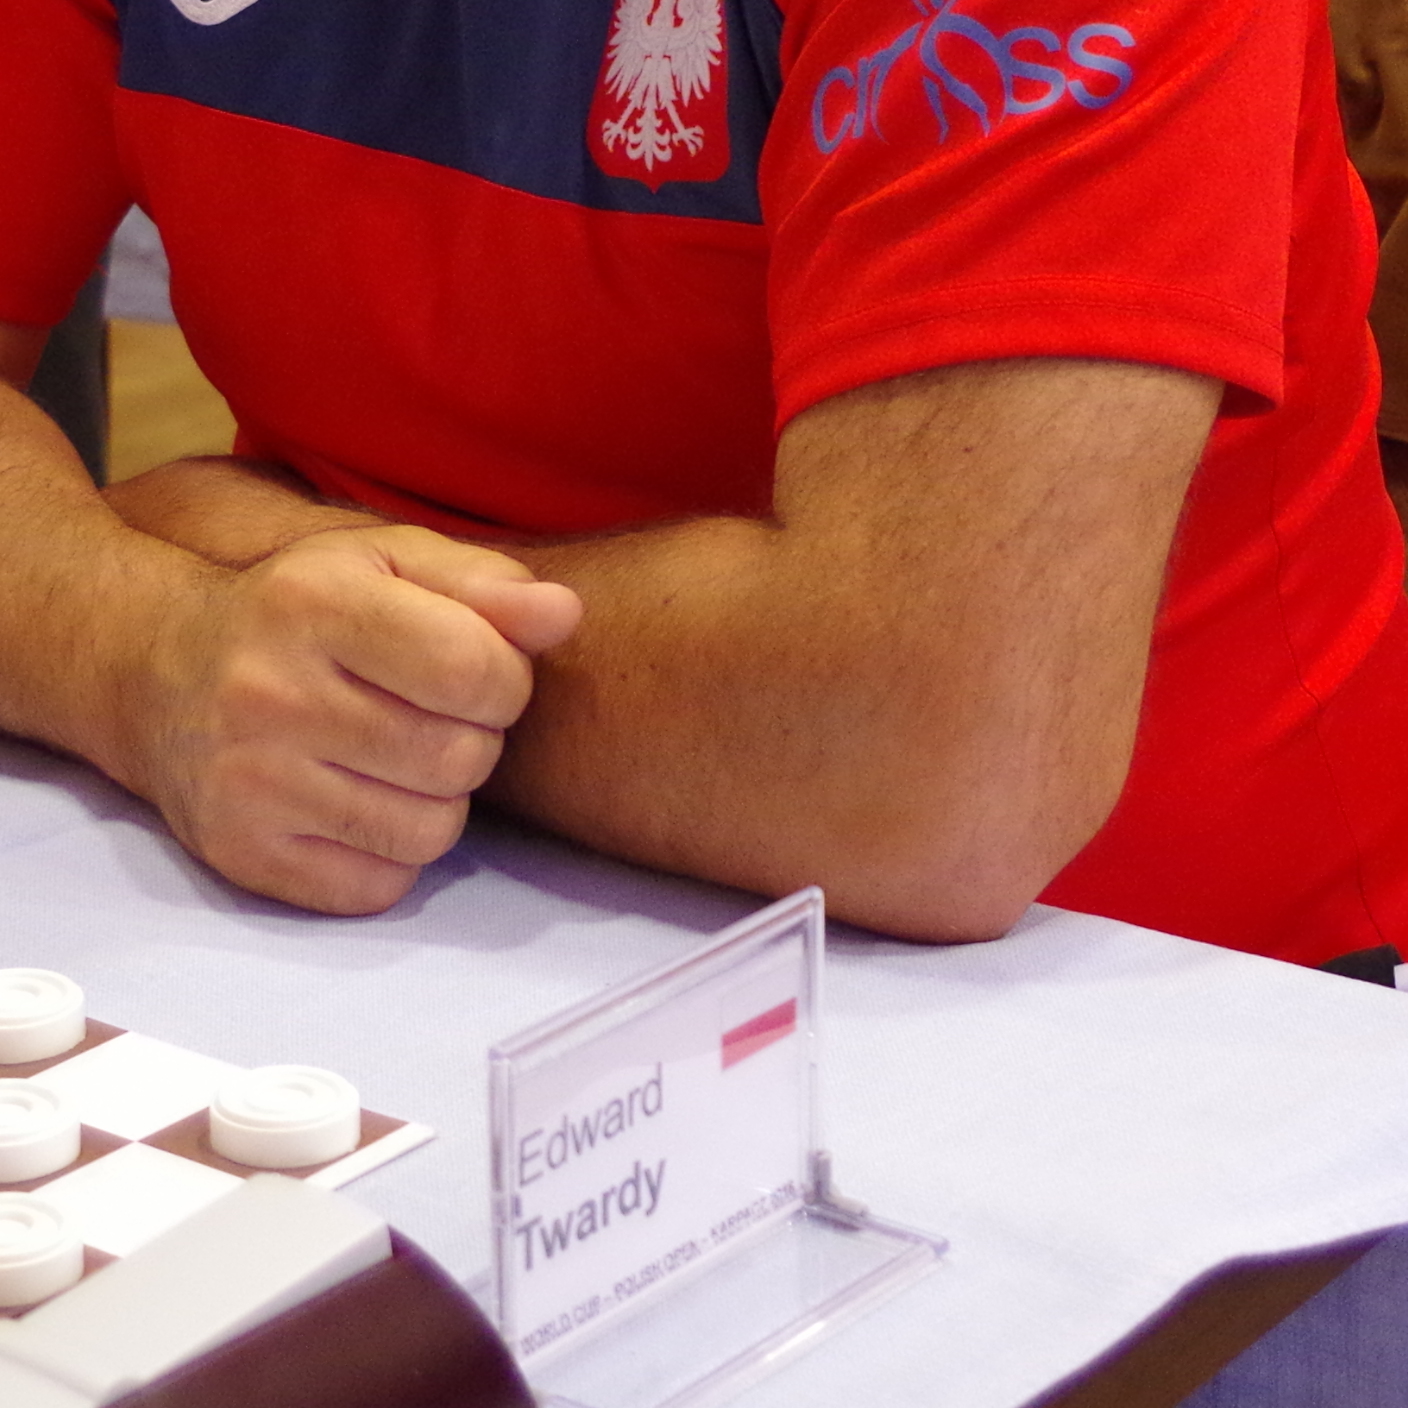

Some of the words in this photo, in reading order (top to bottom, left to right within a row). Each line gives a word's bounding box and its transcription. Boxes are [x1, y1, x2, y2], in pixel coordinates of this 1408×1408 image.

[518, 1061, 662, 1188] Edward
[515, 1158, 666, 1272] Twardy
[521, 1312, 573, 1355] WORLD
[573, 1294, 600, 1325] CUP
[614, 1259, 664, 1301] POLISH
[663, 1240, 702, 1272] OPEN
